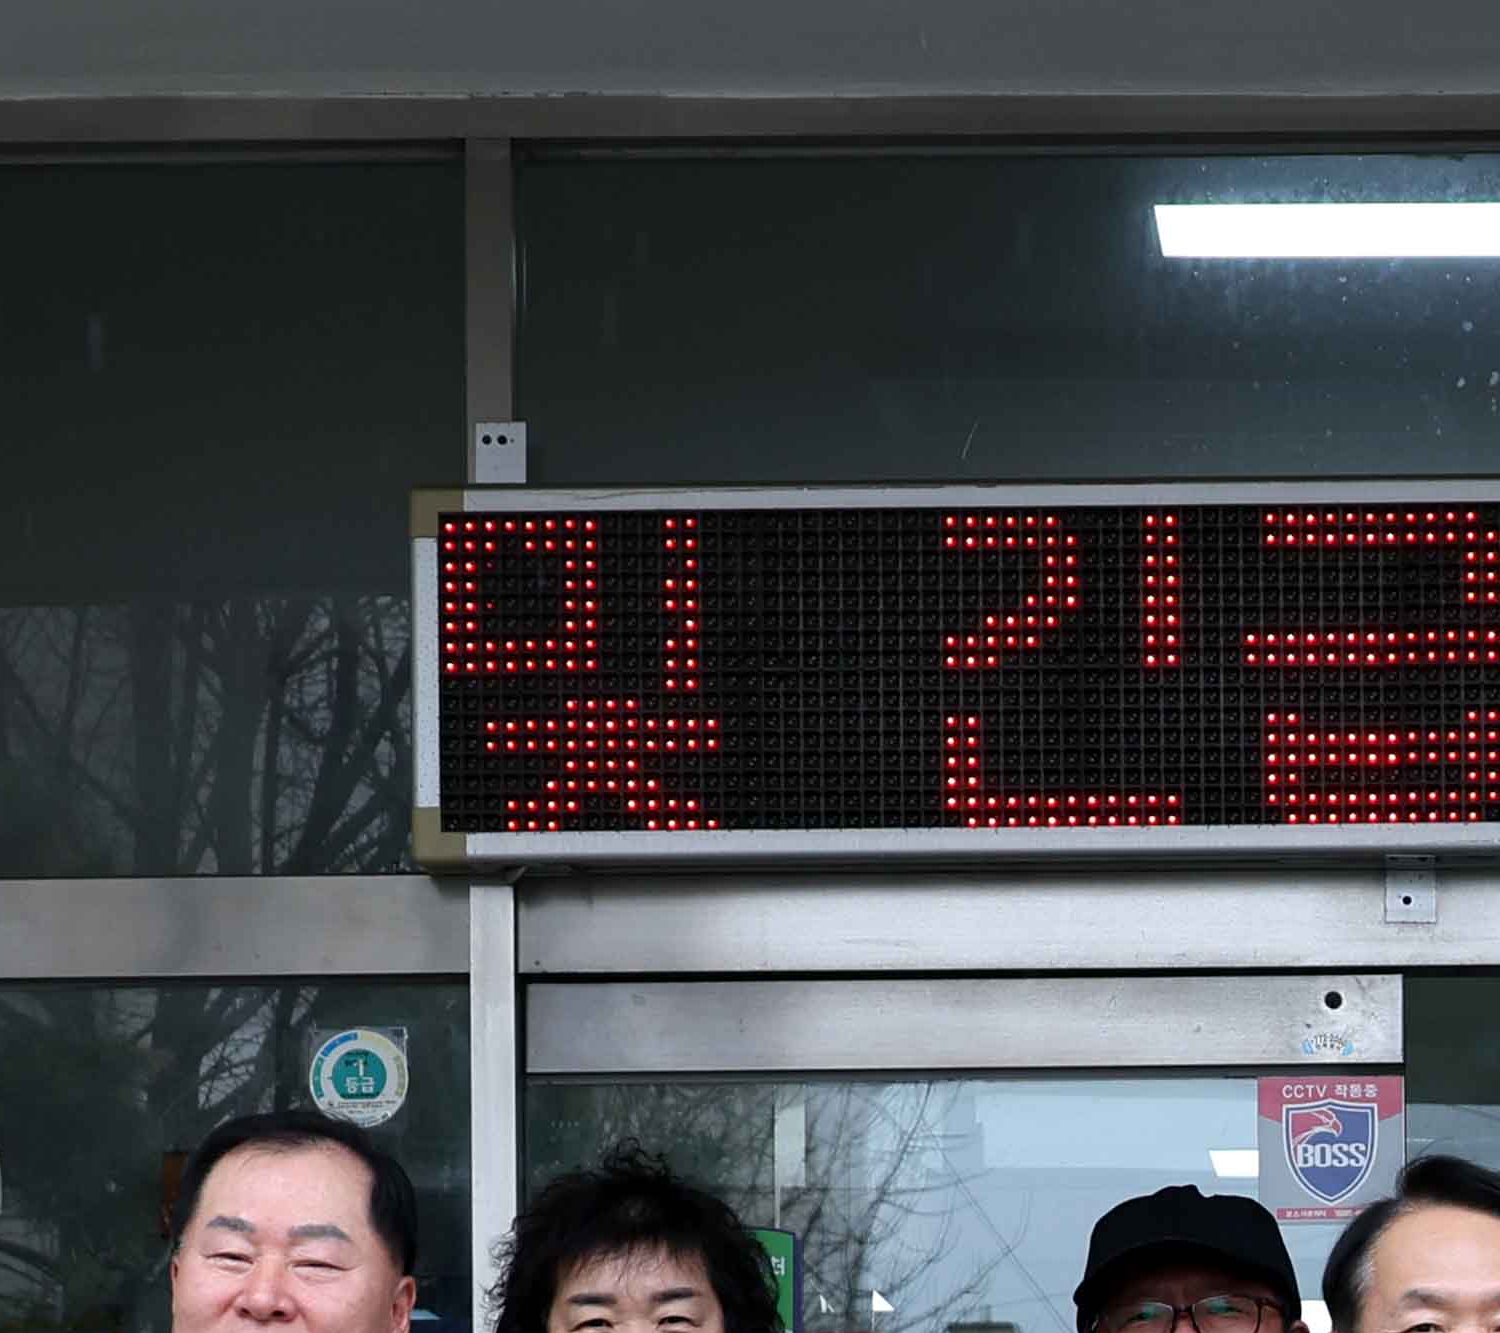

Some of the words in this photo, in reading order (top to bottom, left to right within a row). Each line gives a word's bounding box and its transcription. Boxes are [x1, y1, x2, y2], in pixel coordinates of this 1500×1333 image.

[444, 517, 718, 830] 및
[346, 1077, 375, 1093] 등급
[1283, 1085, 1327, 1098] CCTV
[1335, 1084, 1378, 1097] 작동중
[1297, 1144, 1365, 1167] BOSS
